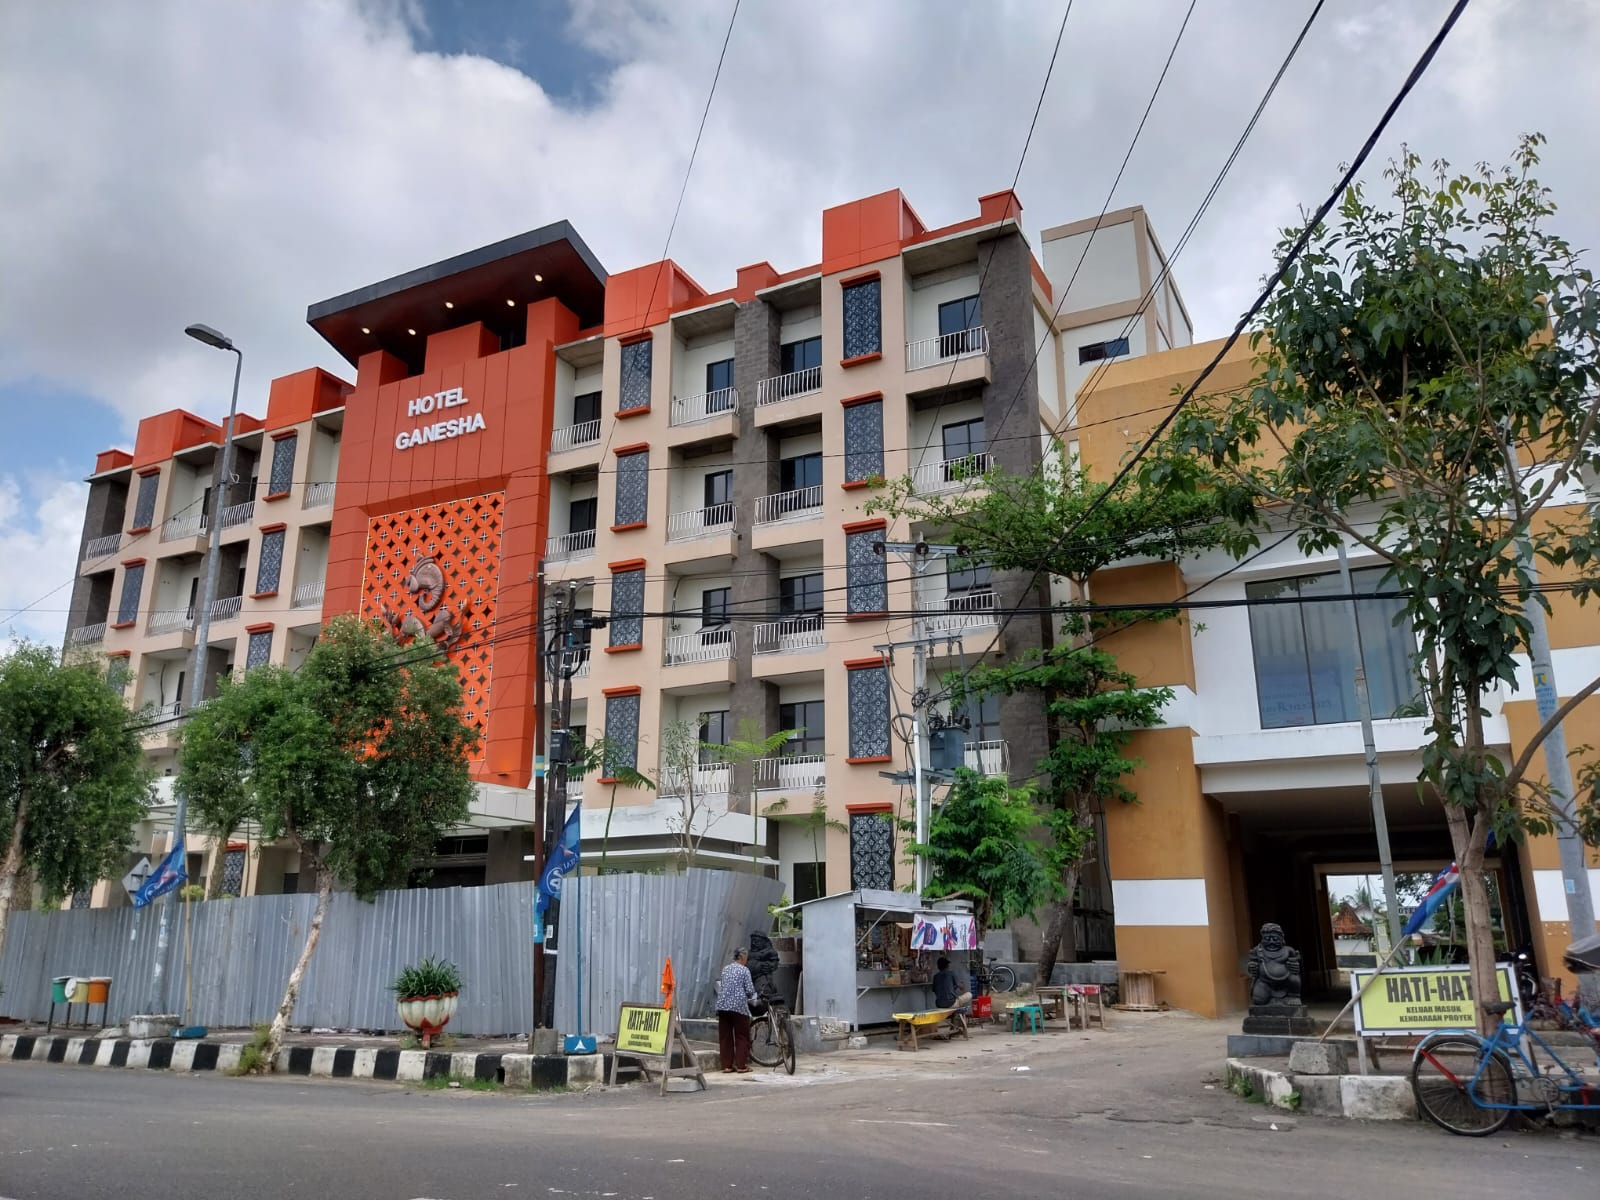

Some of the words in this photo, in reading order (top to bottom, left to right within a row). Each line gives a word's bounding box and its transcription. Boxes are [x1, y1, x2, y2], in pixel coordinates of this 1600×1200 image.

[407, 387, 469, 417] HOTEL
[395, 413, 487, 450] GANESHA
[1386, 975, 1474, 1002] HATI-HAT
[628, 1010, 660, 1032] HATI-HATI
[1399, 1014, 1442, 1023] KENDARAAN
[1444, 1014, 1473, 1022] PROYEK
[1434, 1005, 1461, 1013] MASUK
